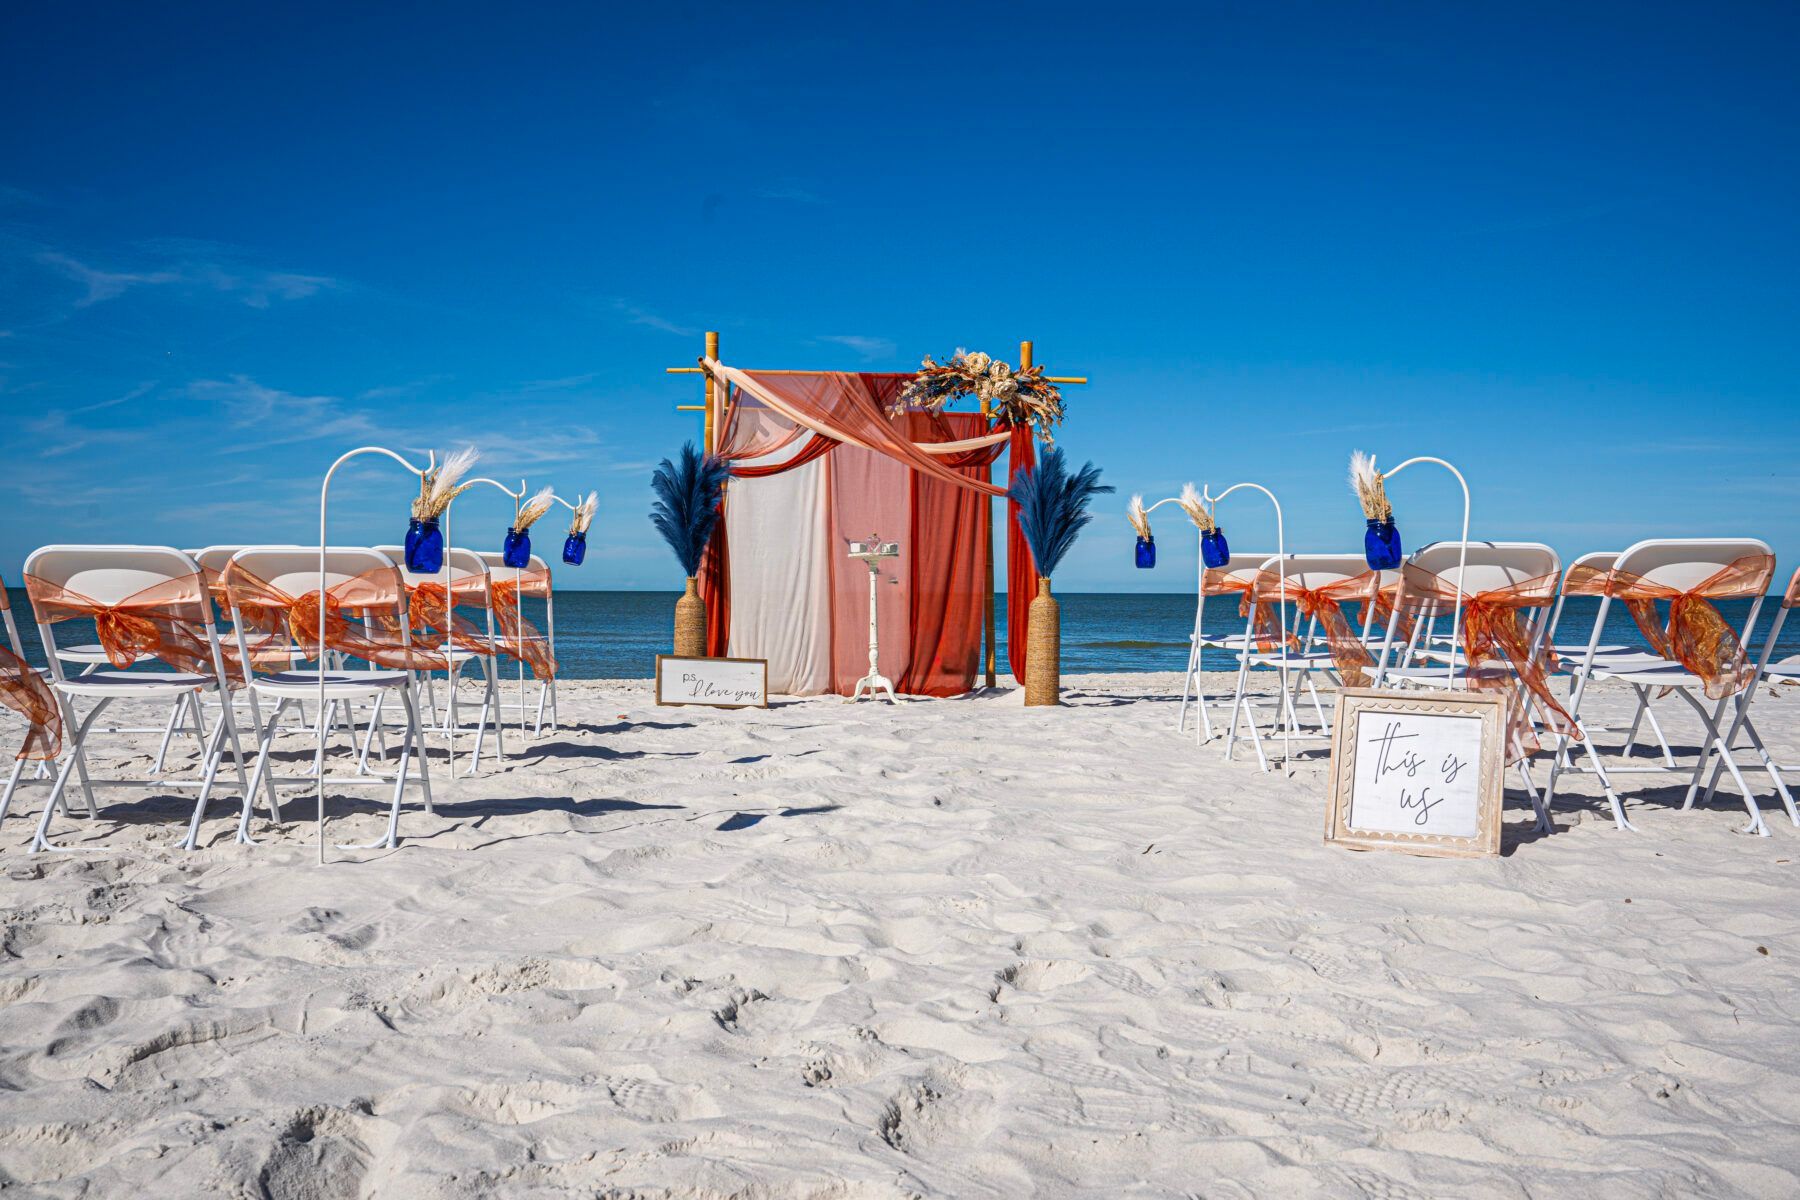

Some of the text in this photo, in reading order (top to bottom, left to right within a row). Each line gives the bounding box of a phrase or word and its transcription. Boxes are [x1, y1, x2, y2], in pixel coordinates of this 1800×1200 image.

[689, 680, 761, 701] I love you
[1441, 753, 1467, 784] is
[1400, 787, 1444, 825] us
